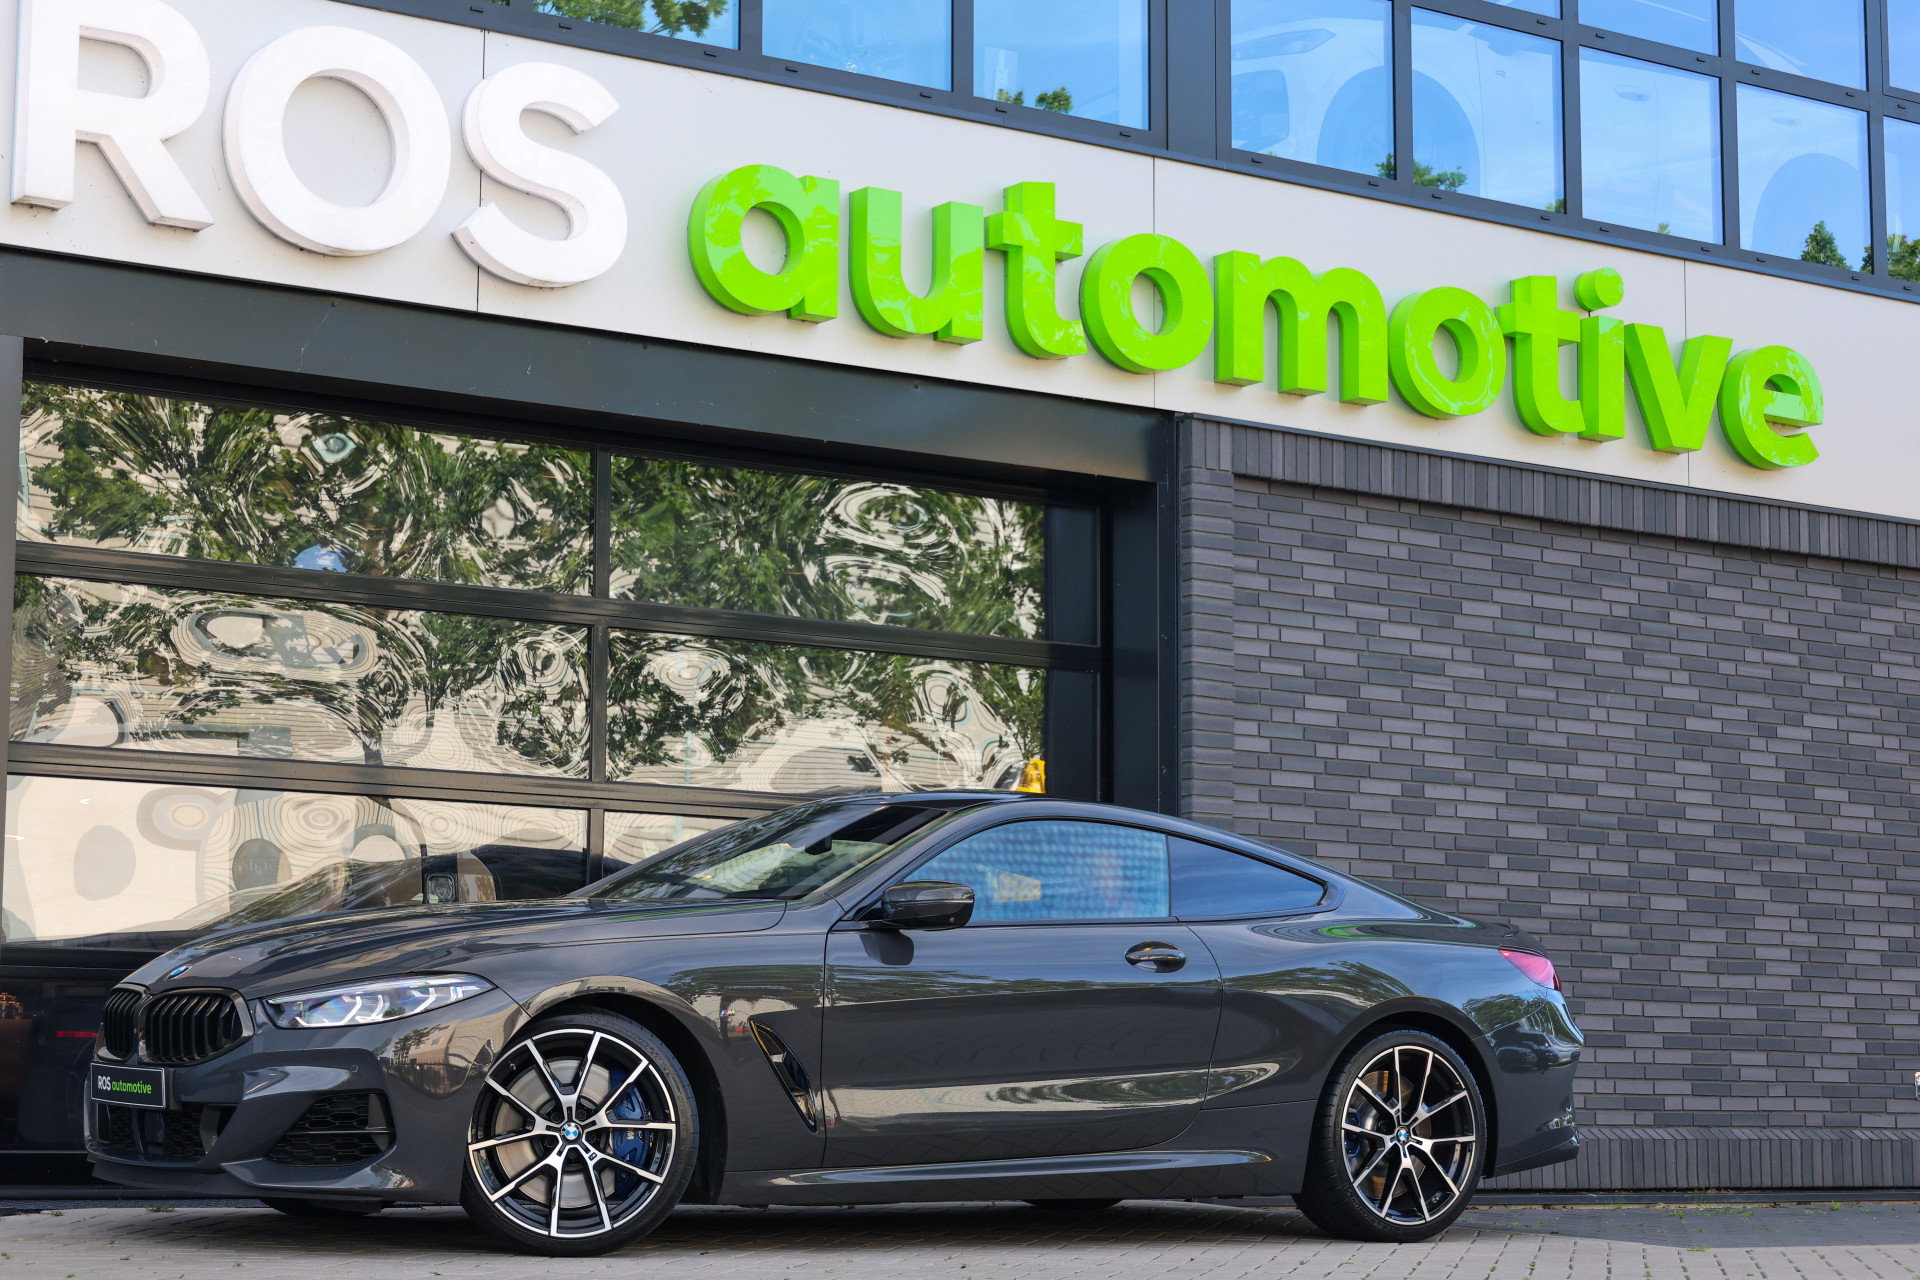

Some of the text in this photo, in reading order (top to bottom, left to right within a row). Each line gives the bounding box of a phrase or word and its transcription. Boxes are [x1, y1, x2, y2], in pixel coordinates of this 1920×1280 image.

[11, 0, 1824, 471] ROS automotive
[98, 1076, 152, 1094] ROS automotive
